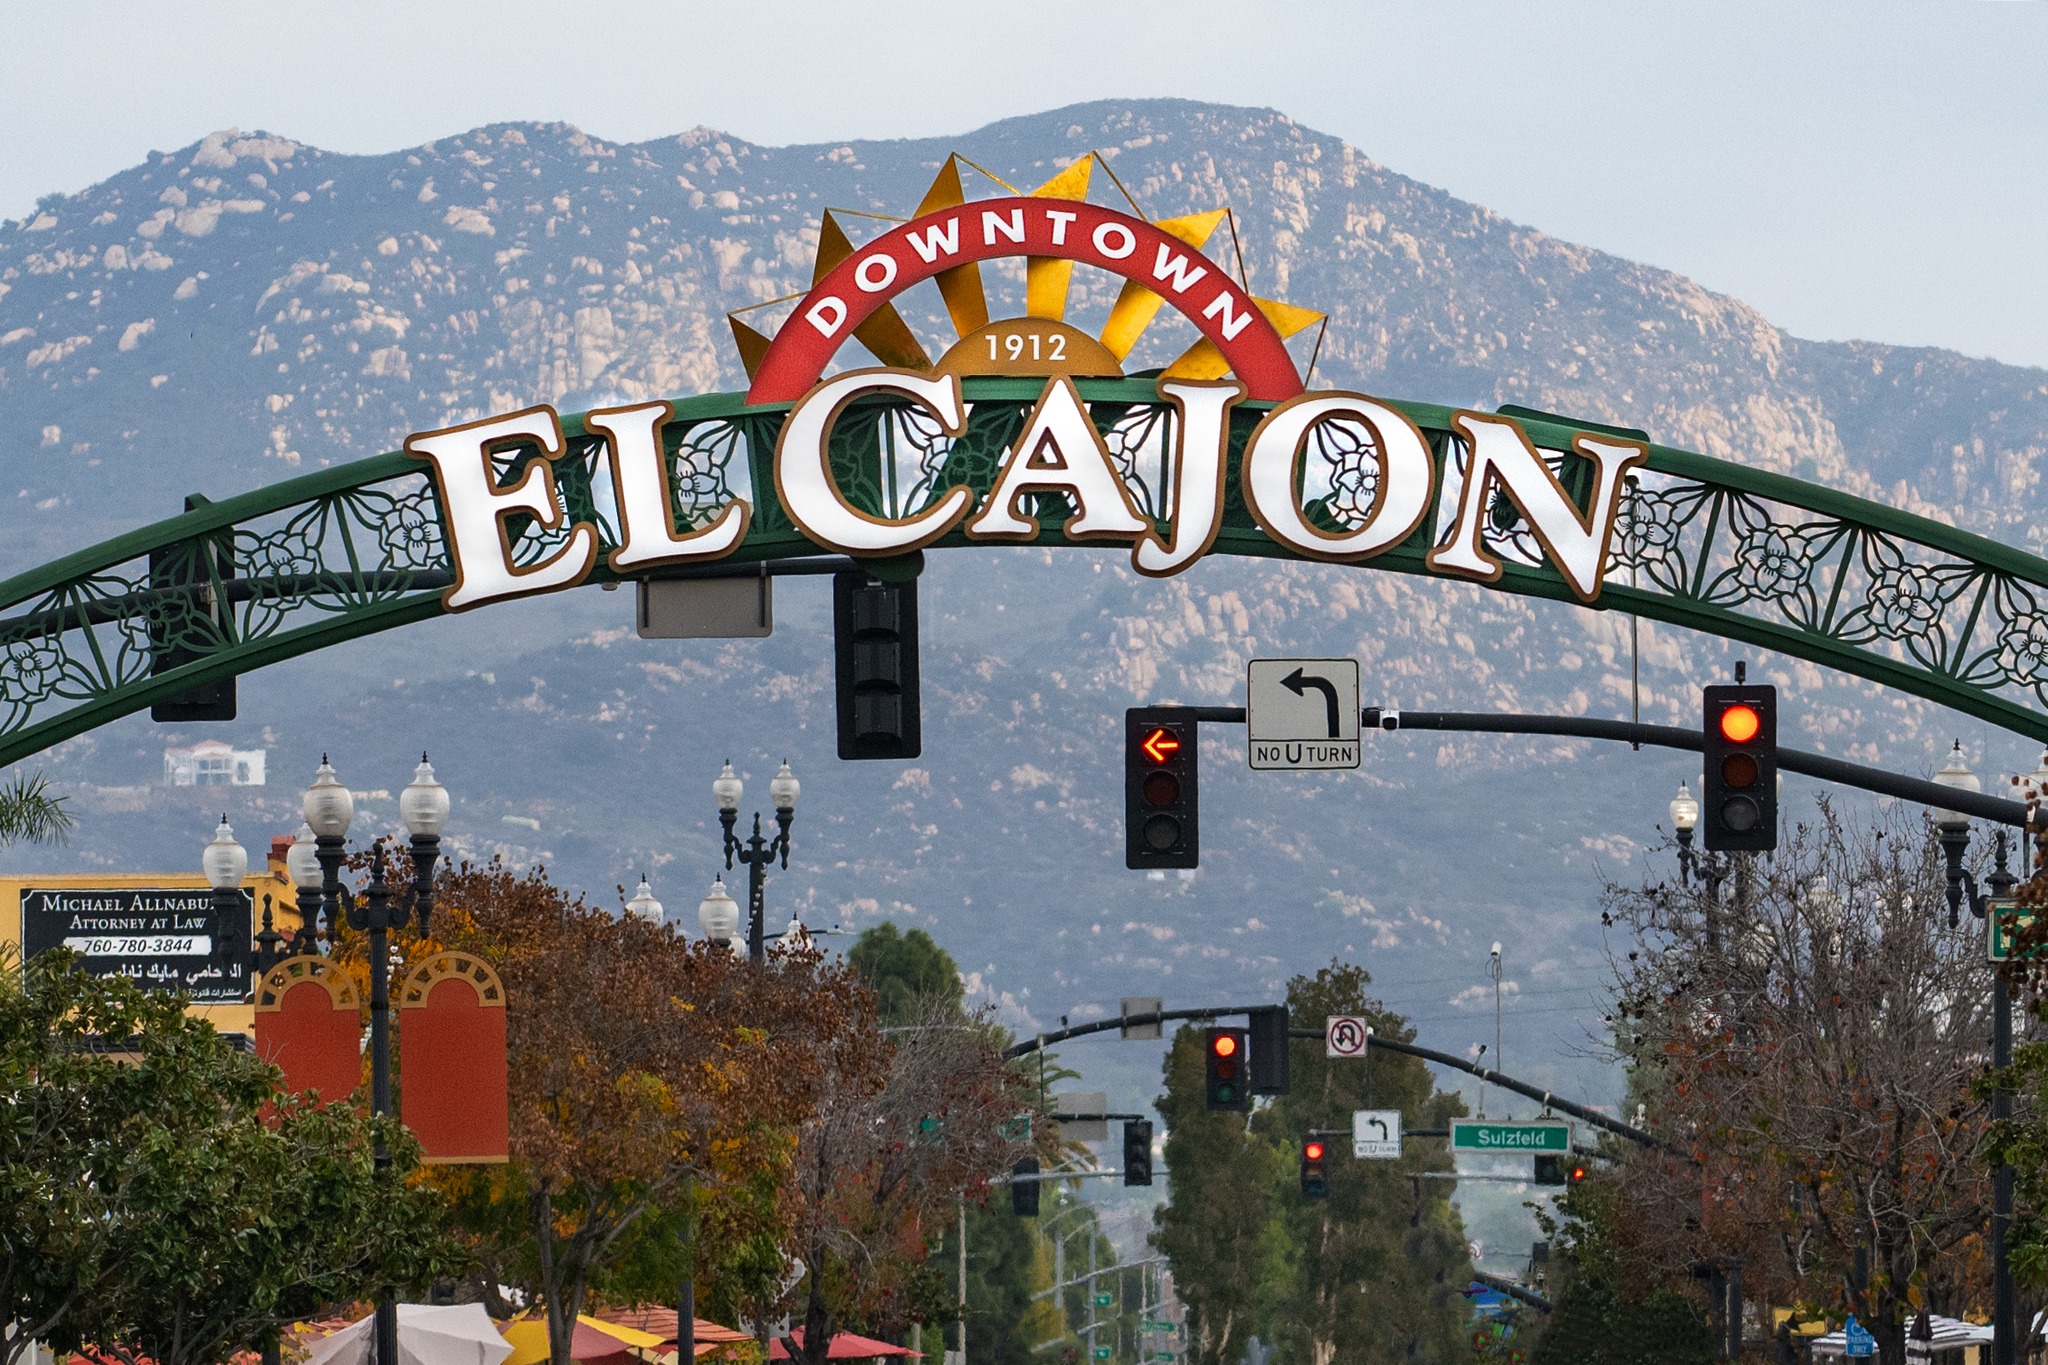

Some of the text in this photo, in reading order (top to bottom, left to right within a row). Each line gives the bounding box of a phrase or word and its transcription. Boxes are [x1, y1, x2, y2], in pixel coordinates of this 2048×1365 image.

[805, 208, 1254, 342] DOWNTOWN
[985, 334, 1067, 361] 1912
[404, 366, 1648, 612] EL CAJON
[1257, 743, 1352, 764] NO U TURN
[42, 894, 124, 912] MICHAEL
[69, 914, 207, 930] ATTORNEY AT LAW
[84, 938, 194, 954] 760-780-3844
[1478, 1128, 1546, 1146] Sulzfeld
